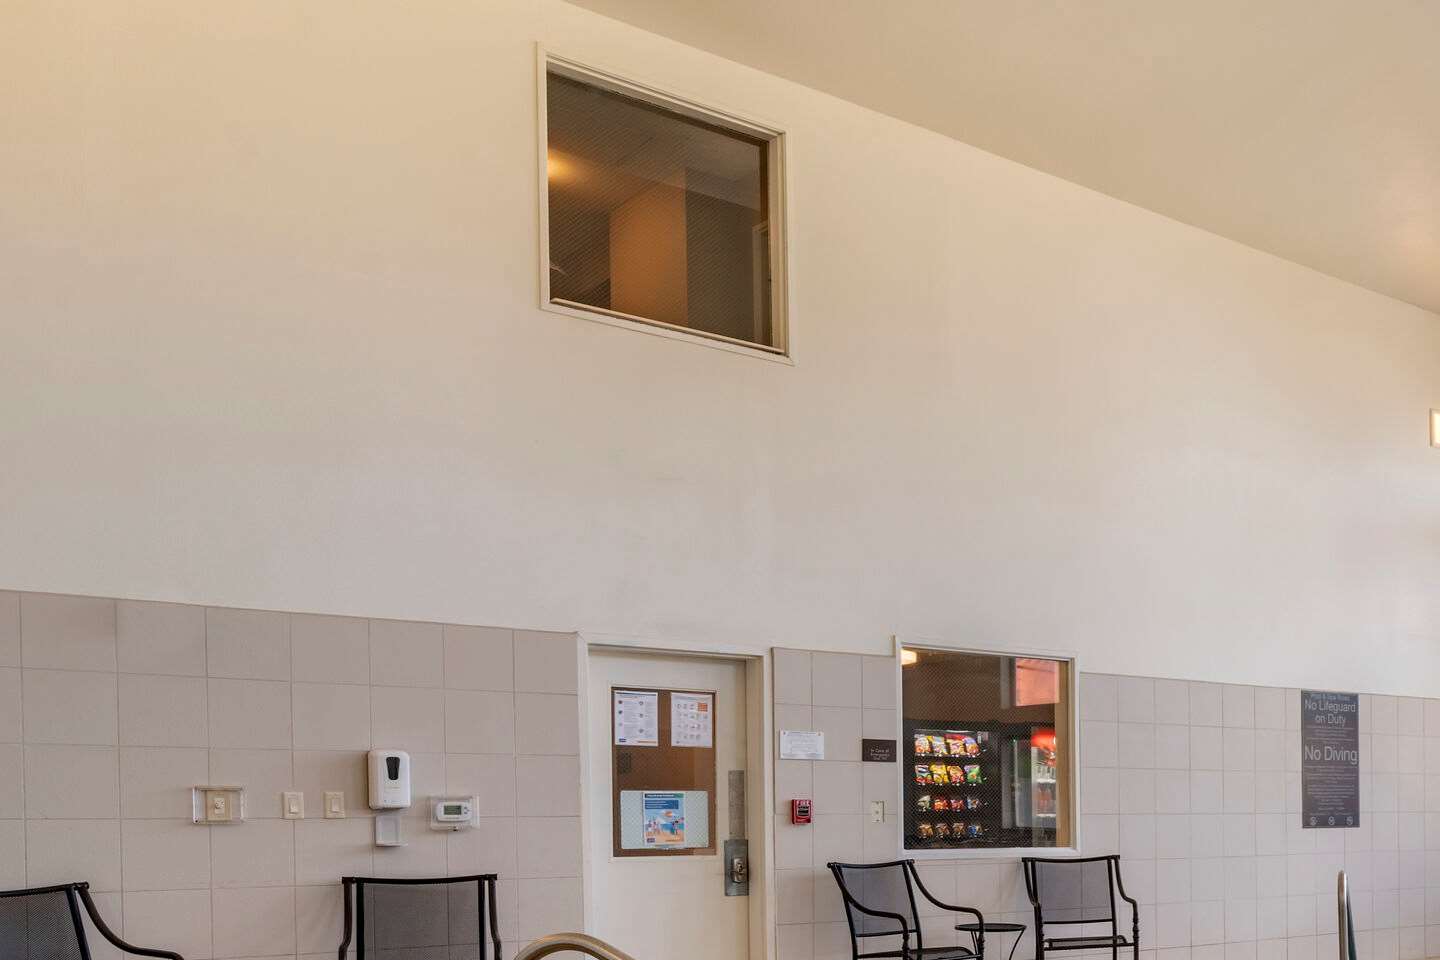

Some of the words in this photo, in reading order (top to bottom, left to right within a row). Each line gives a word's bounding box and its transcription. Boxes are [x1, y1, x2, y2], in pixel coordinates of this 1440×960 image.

[1304, 699, 1318, 710] No
[1318, 700, 1356, 714] Lifeguard
[1327, 713, 1346, 728] Duty
[1304, 745, 1322, 761] No
[1324, 746, 1358, 765] Diving
